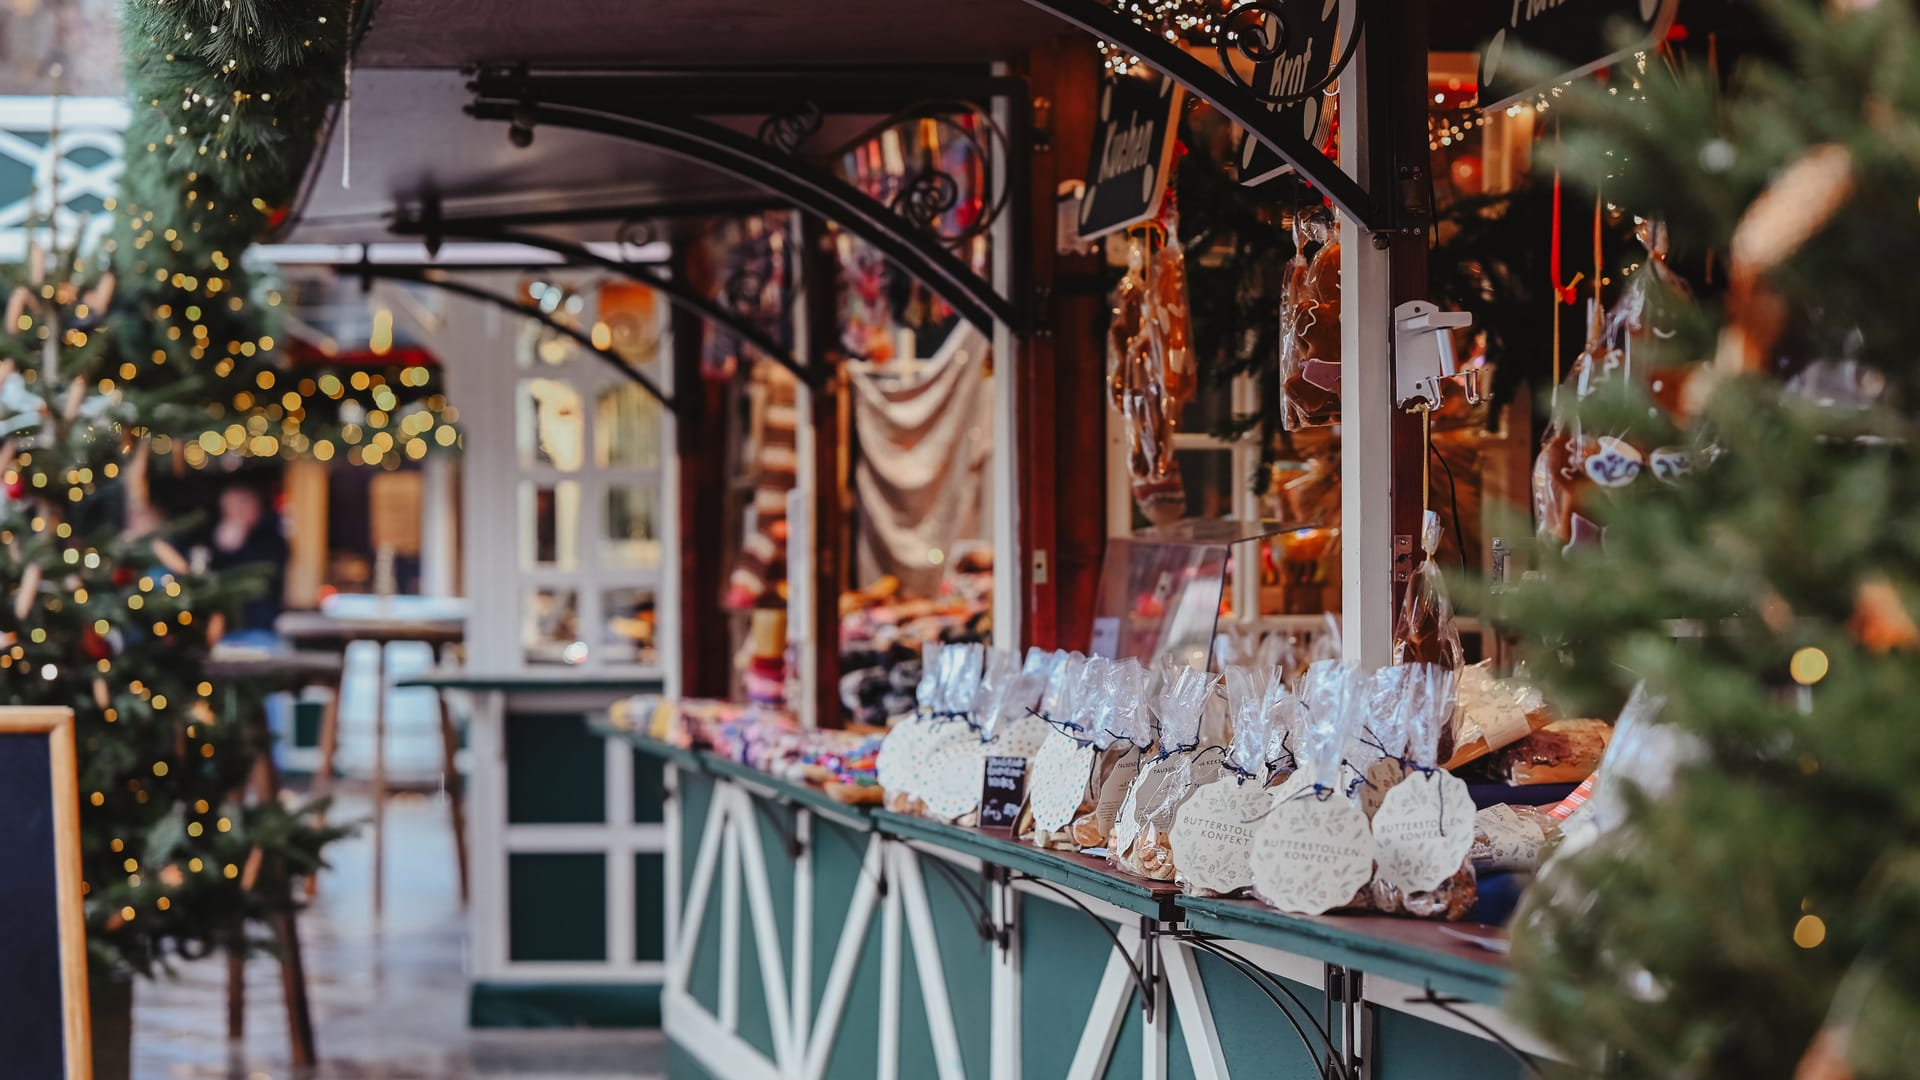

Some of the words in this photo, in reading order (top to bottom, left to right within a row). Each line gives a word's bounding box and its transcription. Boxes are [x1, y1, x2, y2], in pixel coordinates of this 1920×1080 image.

[1266, 36, 1313, 113] Brot
[1183, 815, 1254, 838] BUTTERSTOLL
[1400, 829, 1445, 841] KONFEK
[1200, 829, 1250, 847] KONFEKT
[1284, 851, 1338, 865] KONFEKT
